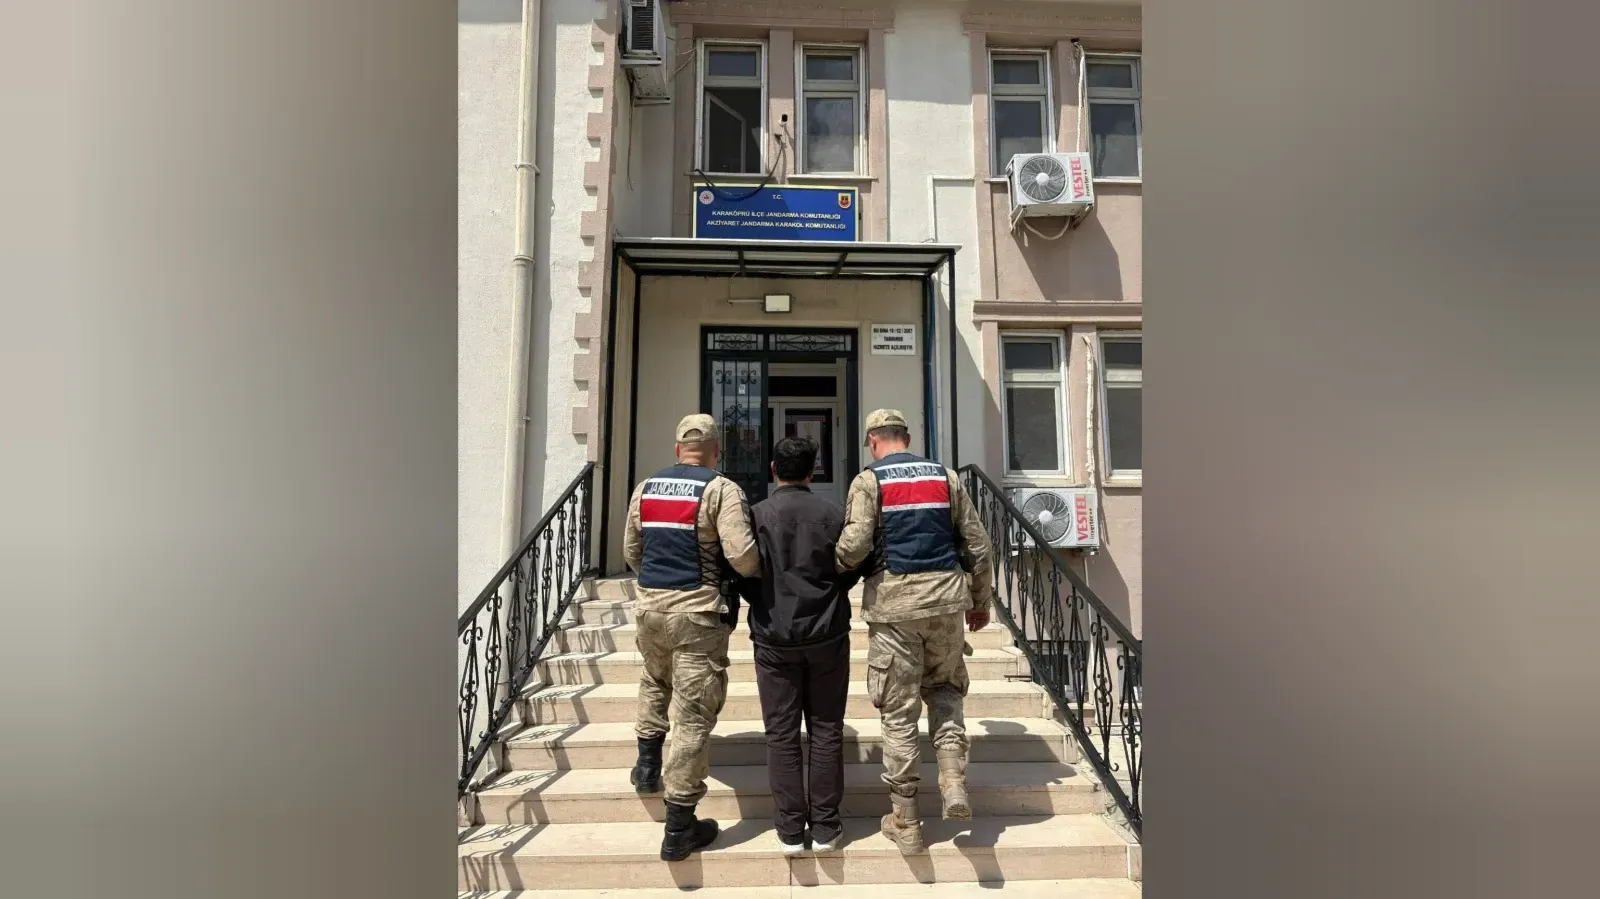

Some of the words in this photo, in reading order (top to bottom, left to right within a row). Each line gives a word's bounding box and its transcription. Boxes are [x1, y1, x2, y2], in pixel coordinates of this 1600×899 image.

[1070, 157, 1084, 199] VESTEL
[800, 212, 841, 220] KOMUTANLIĞI
[706, 219, 740, 227] AKZİYARET
[805, 222, 846, 230] KOMUTANLIĞI
[883, 465, 940, 480] JANDARMA
[647, 482, 695, 497] JANDARMA
[1075, 495, 1088, 541] VESTEL
